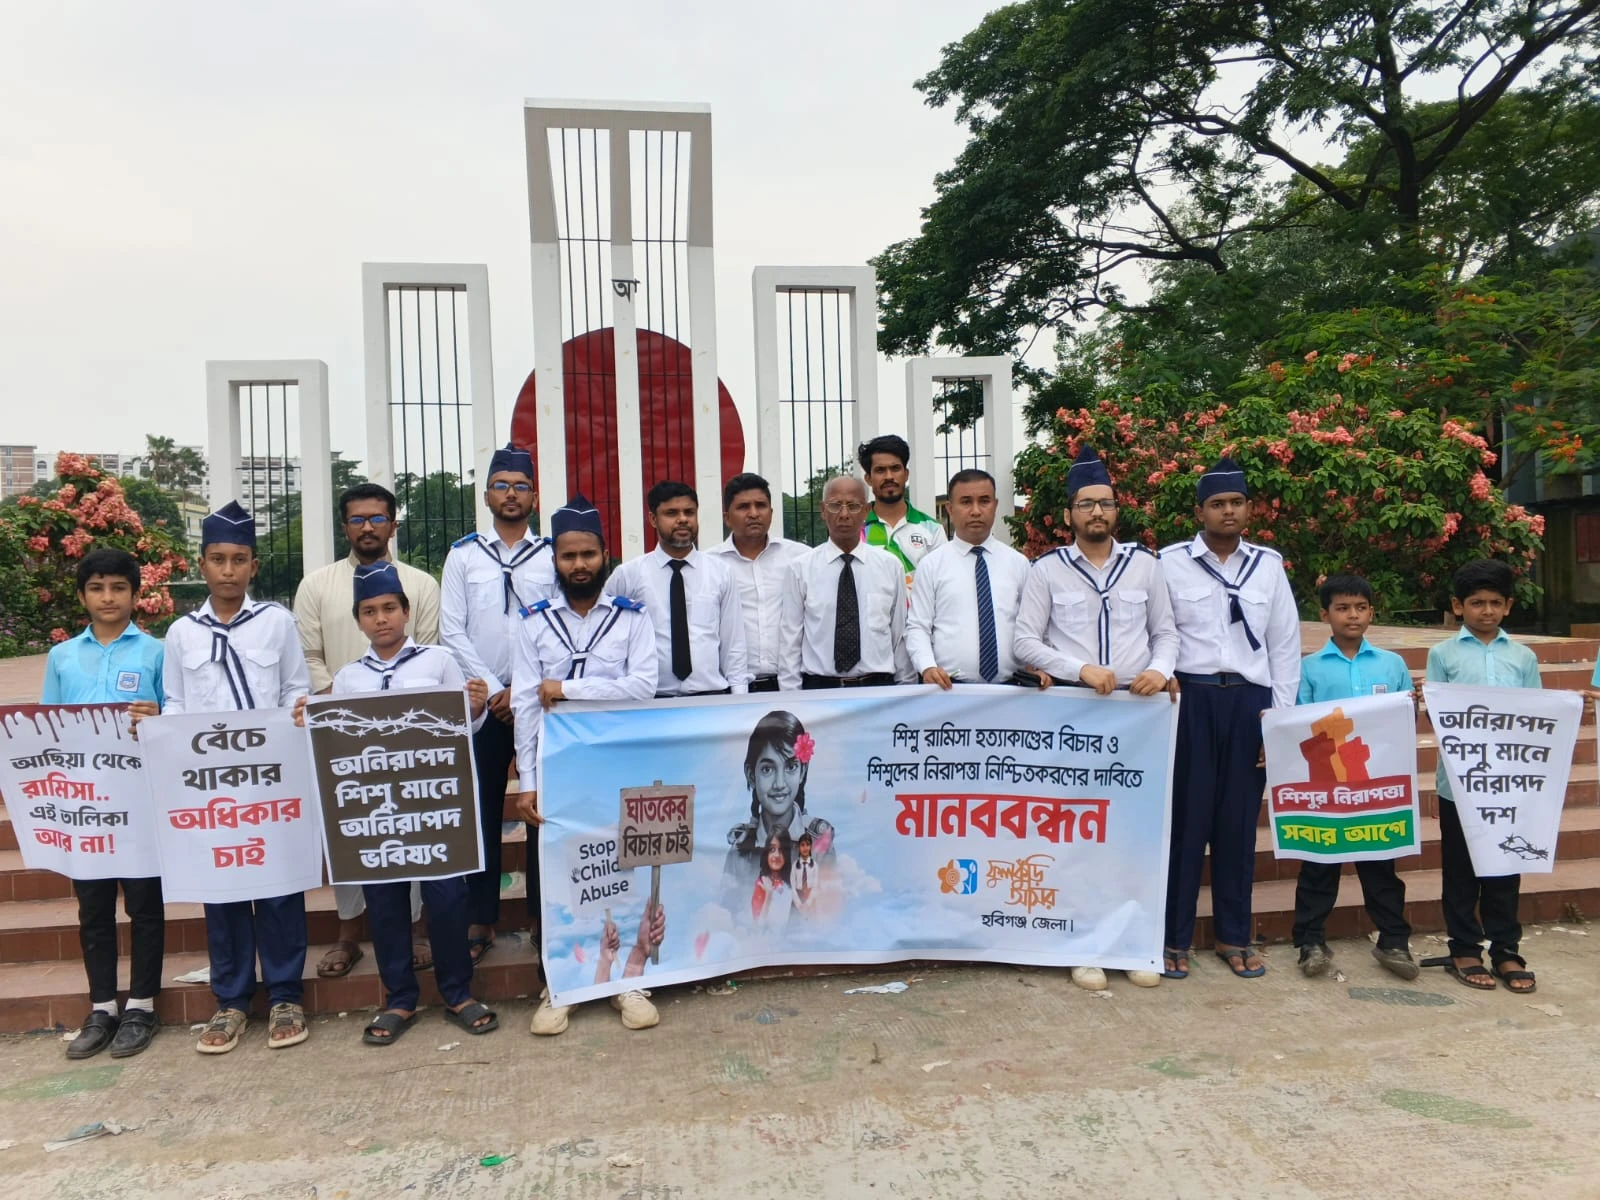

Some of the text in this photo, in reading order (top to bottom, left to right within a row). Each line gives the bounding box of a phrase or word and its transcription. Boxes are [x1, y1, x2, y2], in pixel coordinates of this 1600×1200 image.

[1439, 704, 1558, 735] অনিরাপদ
[191, 722, 266, 754] বেঁচে
[893, 722, 1119, 754] শিশু রামিসা হত্যাকাণ্ডের বিচার ও
[10, 748, 142, 770] আছিয়া থেকে
[330, 745, 456, 776] অনিরাপদ
[1495, 743, 1551, 763] মানে
[182, 763, 281, 791] থাকার
[867, 757, 919, 787] শিশুদের
[923, 756, 980, 782] নিরাপত্তা
[1091, 762, 1144, 788] দাবিতে
[1458, 767, 1546, 795] নিরাপদ
[335, 777, 458, 811] শিশু মানে
[1277, 784, 1404, 810] শিশুর নিরাপত্তা
[29, 802, 128, 827] এই তালিকা
[168, 797, 301, 830] অধিকার
[339, 803, 462, 838] অনিরাপদ
[625, 795, 688, 824] ঘাতকের
[895, 794, 1110, 843] মানববন্ধন
[33, 828, 72, 853] আর
[623, 823, 690, 858] বিচার চাই
[1281, 820, 1407, 846] সবার আগে
[212, 837, 265, 868] চাই
[358, 839, 447, 869] ভবিষ্যৎ
[579, 840, 616, 860] Stop
[580, 880, 629, 905] Abuse
[981, 910, 1027, 929] হবিগঞ্জ
